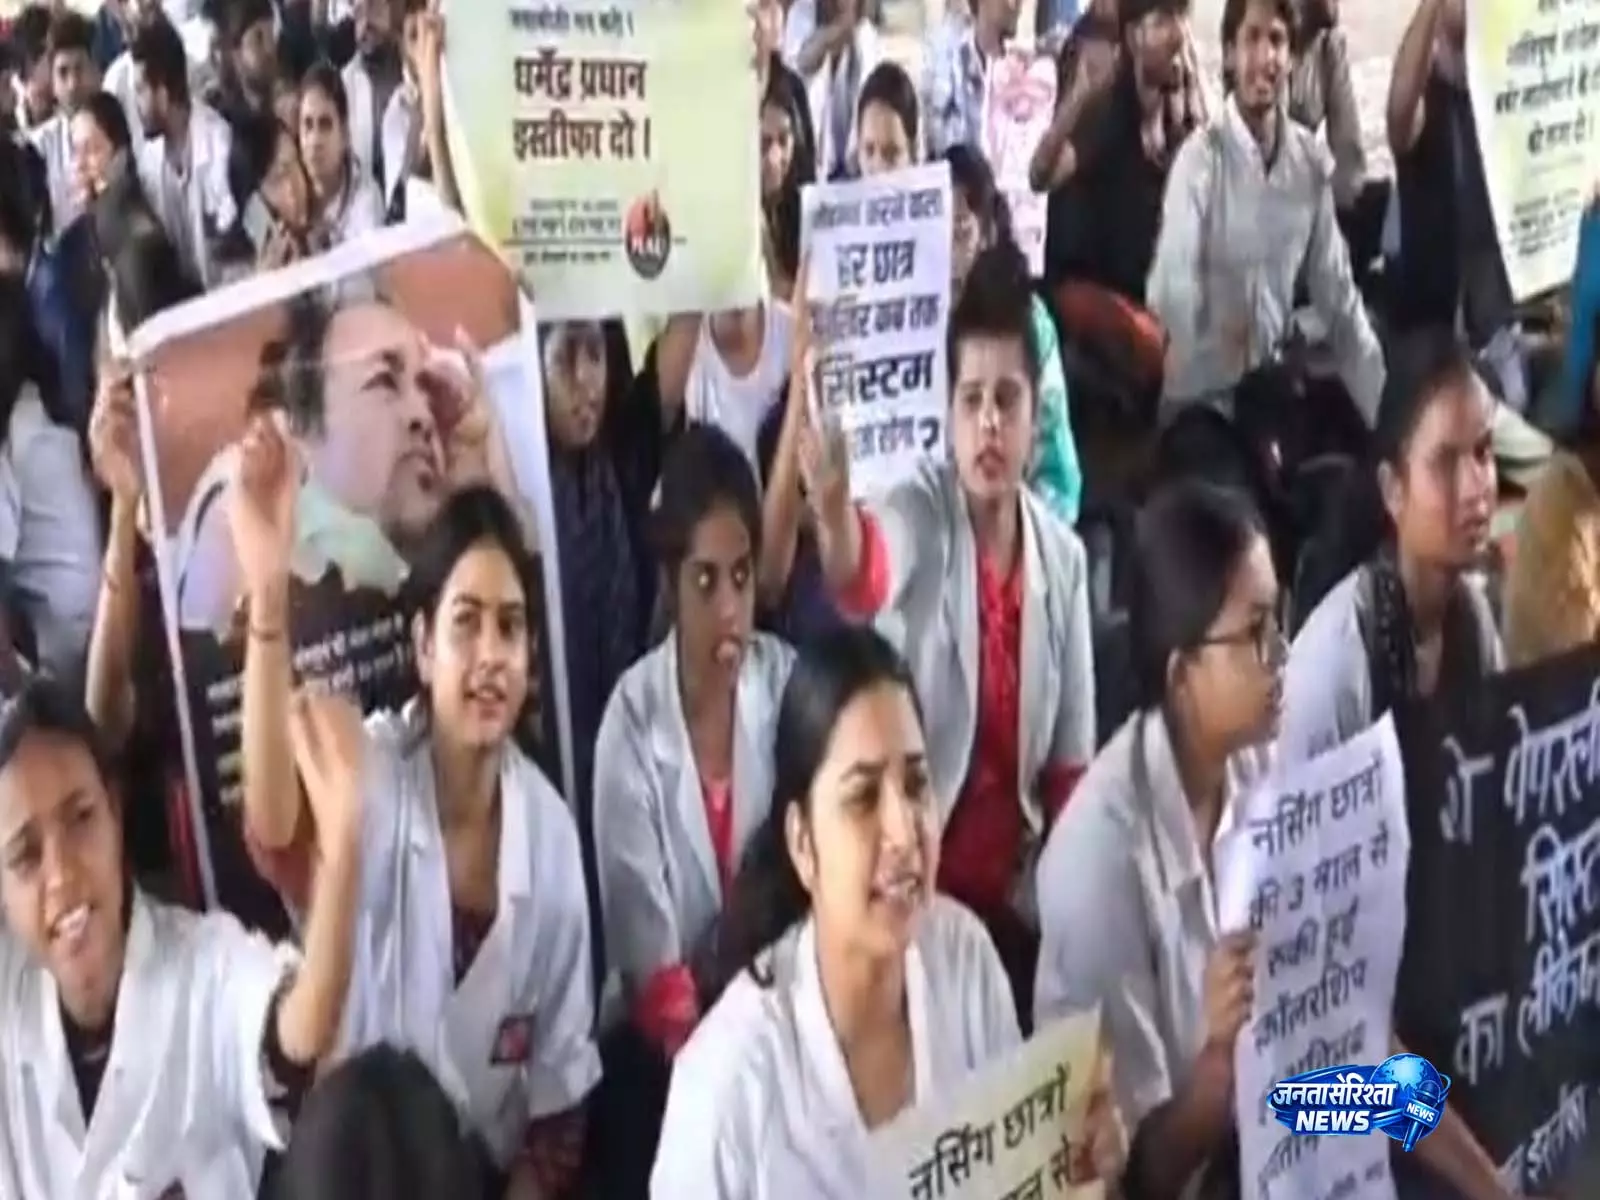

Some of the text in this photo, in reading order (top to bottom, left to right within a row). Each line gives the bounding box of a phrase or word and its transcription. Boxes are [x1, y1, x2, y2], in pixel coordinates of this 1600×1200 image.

[581, 59, 648, 100] प्रधान
[512, 109, 604, 161] इस्तीफा
[873, 239, 916, 284] छात्र
[1454, 993, 1507, 1086] का
